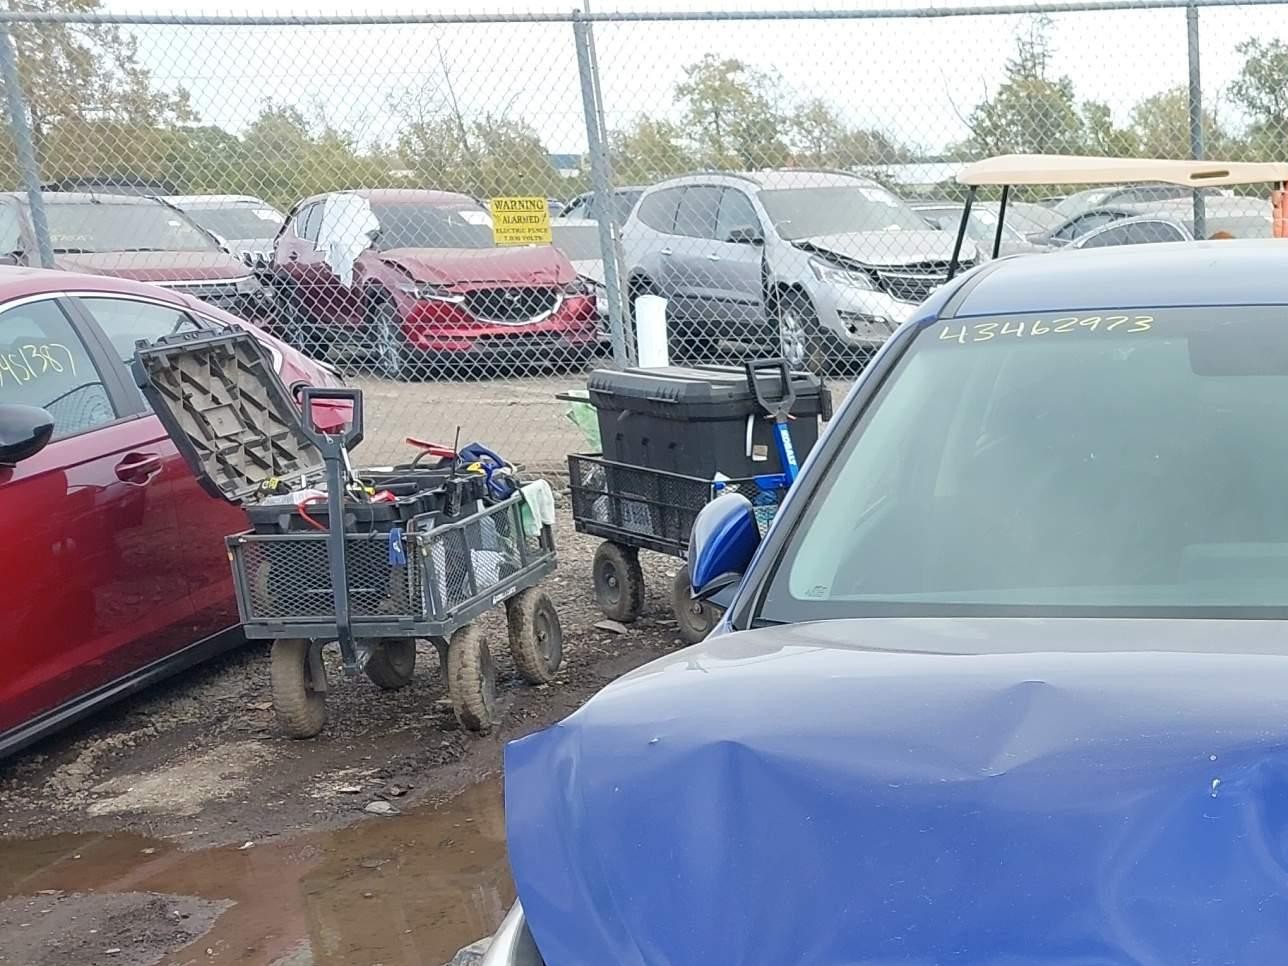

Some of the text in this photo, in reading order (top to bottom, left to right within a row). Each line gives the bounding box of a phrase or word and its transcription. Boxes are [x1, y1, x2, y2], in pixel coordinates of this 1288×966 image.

[494, 199, 544, 210] WARNING
[502, 215, 540, 224] ALARMED
[938, 315, 1154, 344] 43462973
[0, 343, 77, 388] 451387
